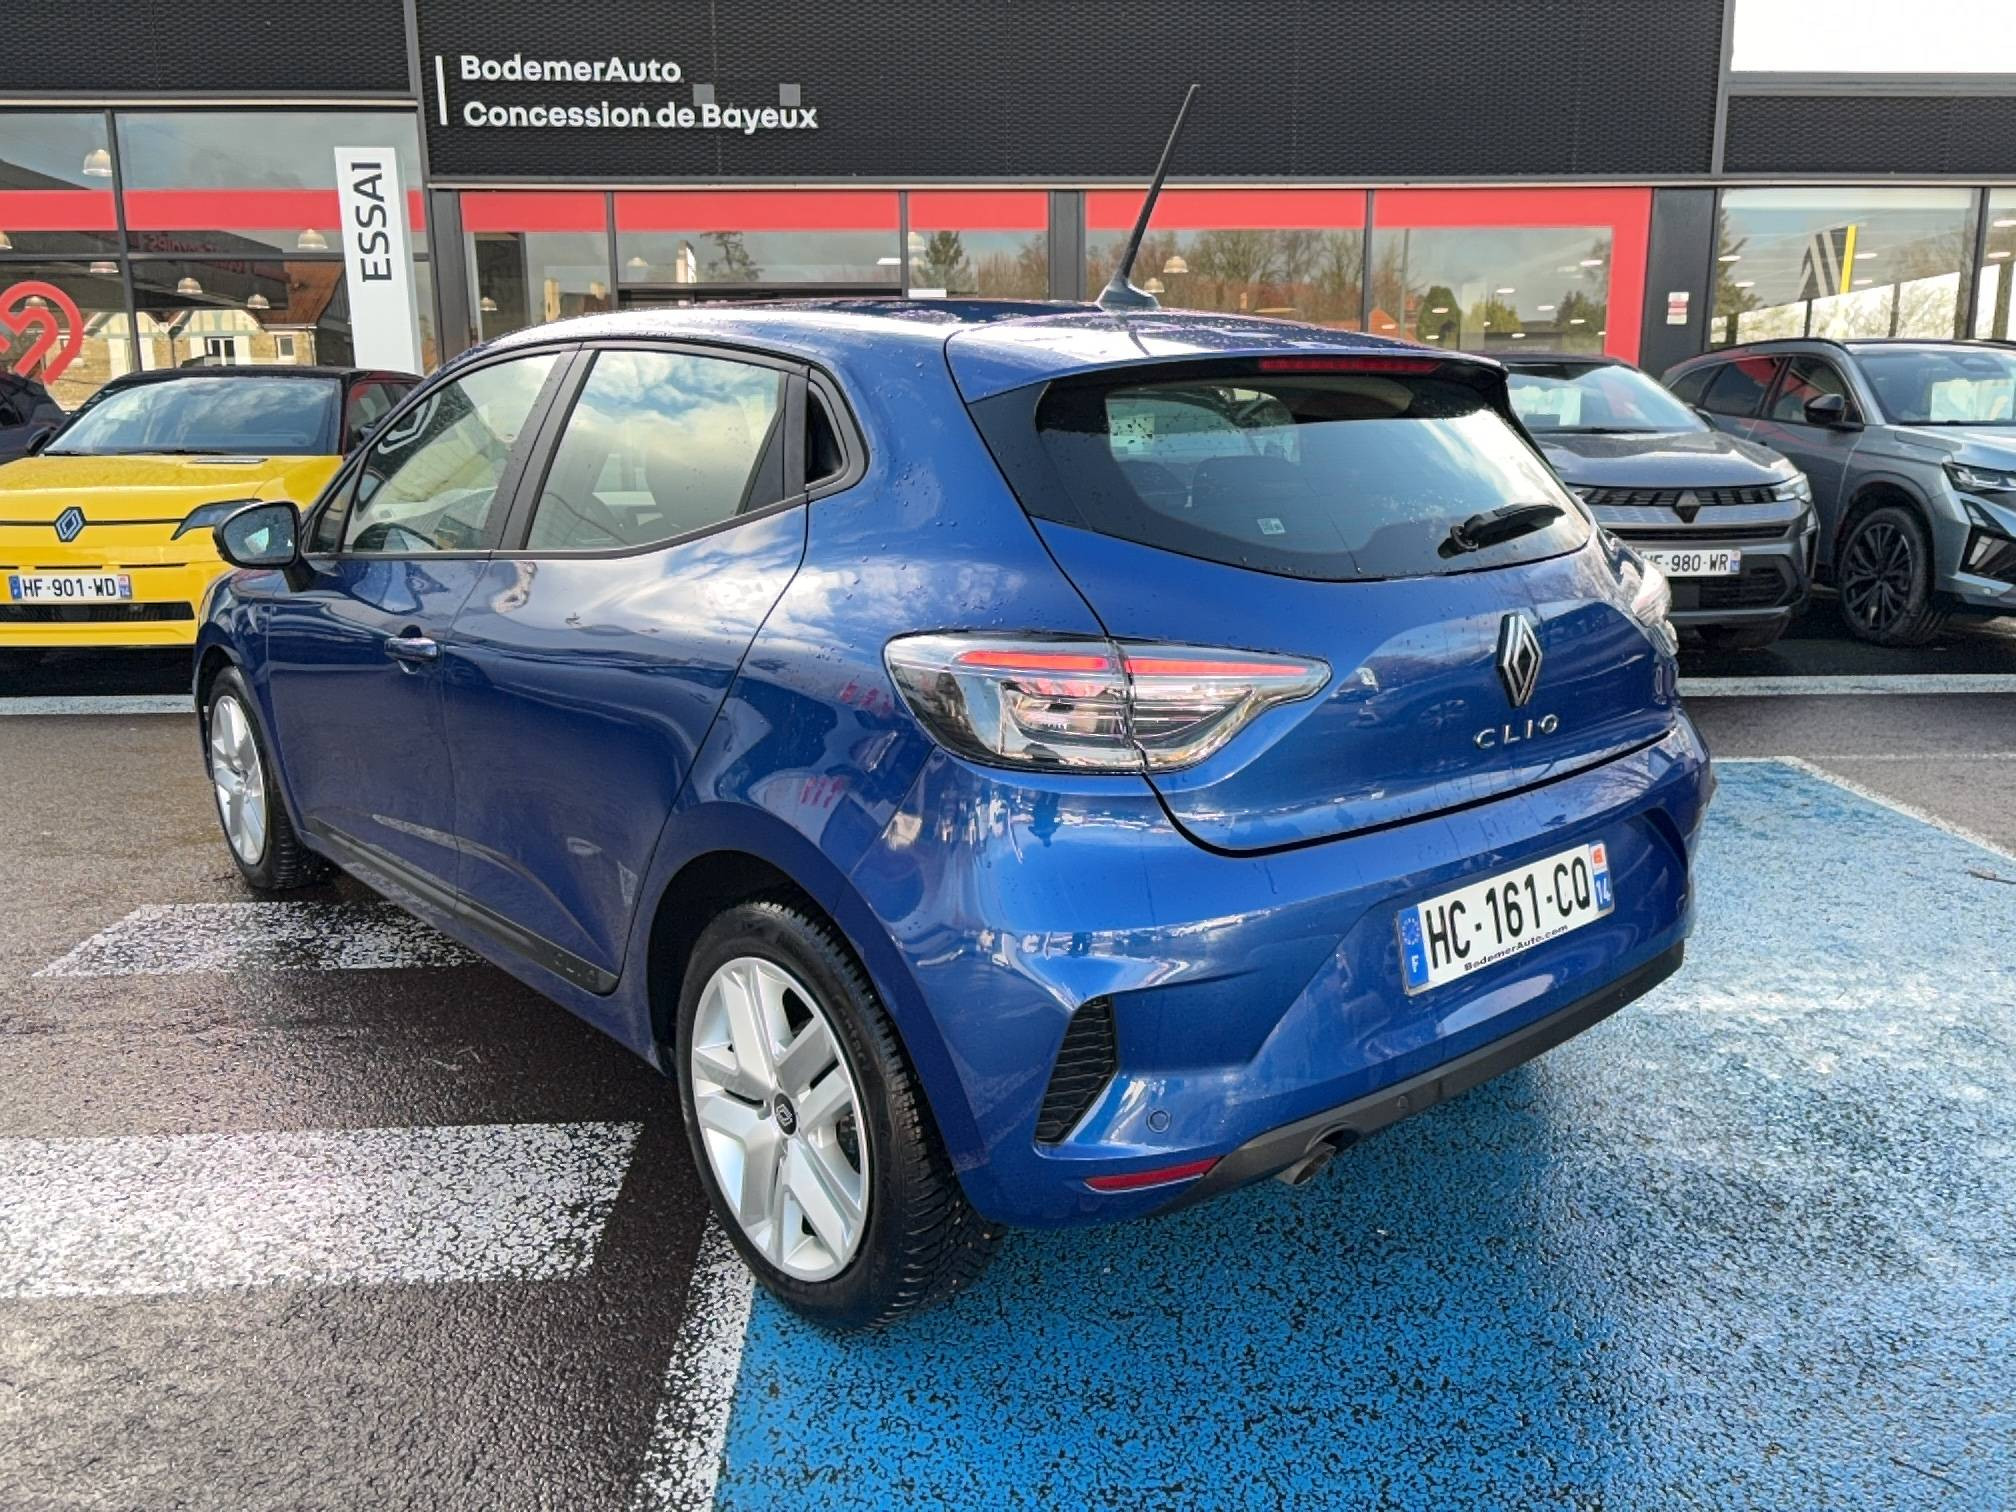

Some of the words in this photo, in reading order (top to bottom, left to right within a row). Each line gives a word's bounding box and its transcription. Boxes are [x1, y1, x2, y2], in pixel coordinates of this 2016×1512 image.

[461, 53, 682, 83] BodemerAuto
[463, 101, 651, 128] Concession
[656, 102, 696, 128] de
[701, 103, 819, 135] Bayeux
[351, 162, 393, 283] ESSAI
[22, 577, 117, 598] HF-901-WD
[1473, 713, 1559, 750] CLIO
[1594, 879, 1612, 904] 14
[1424, 856, 1591, 970] HC-161-CQ
[1463, 922, 1569, 972] BodemerAuto.com
